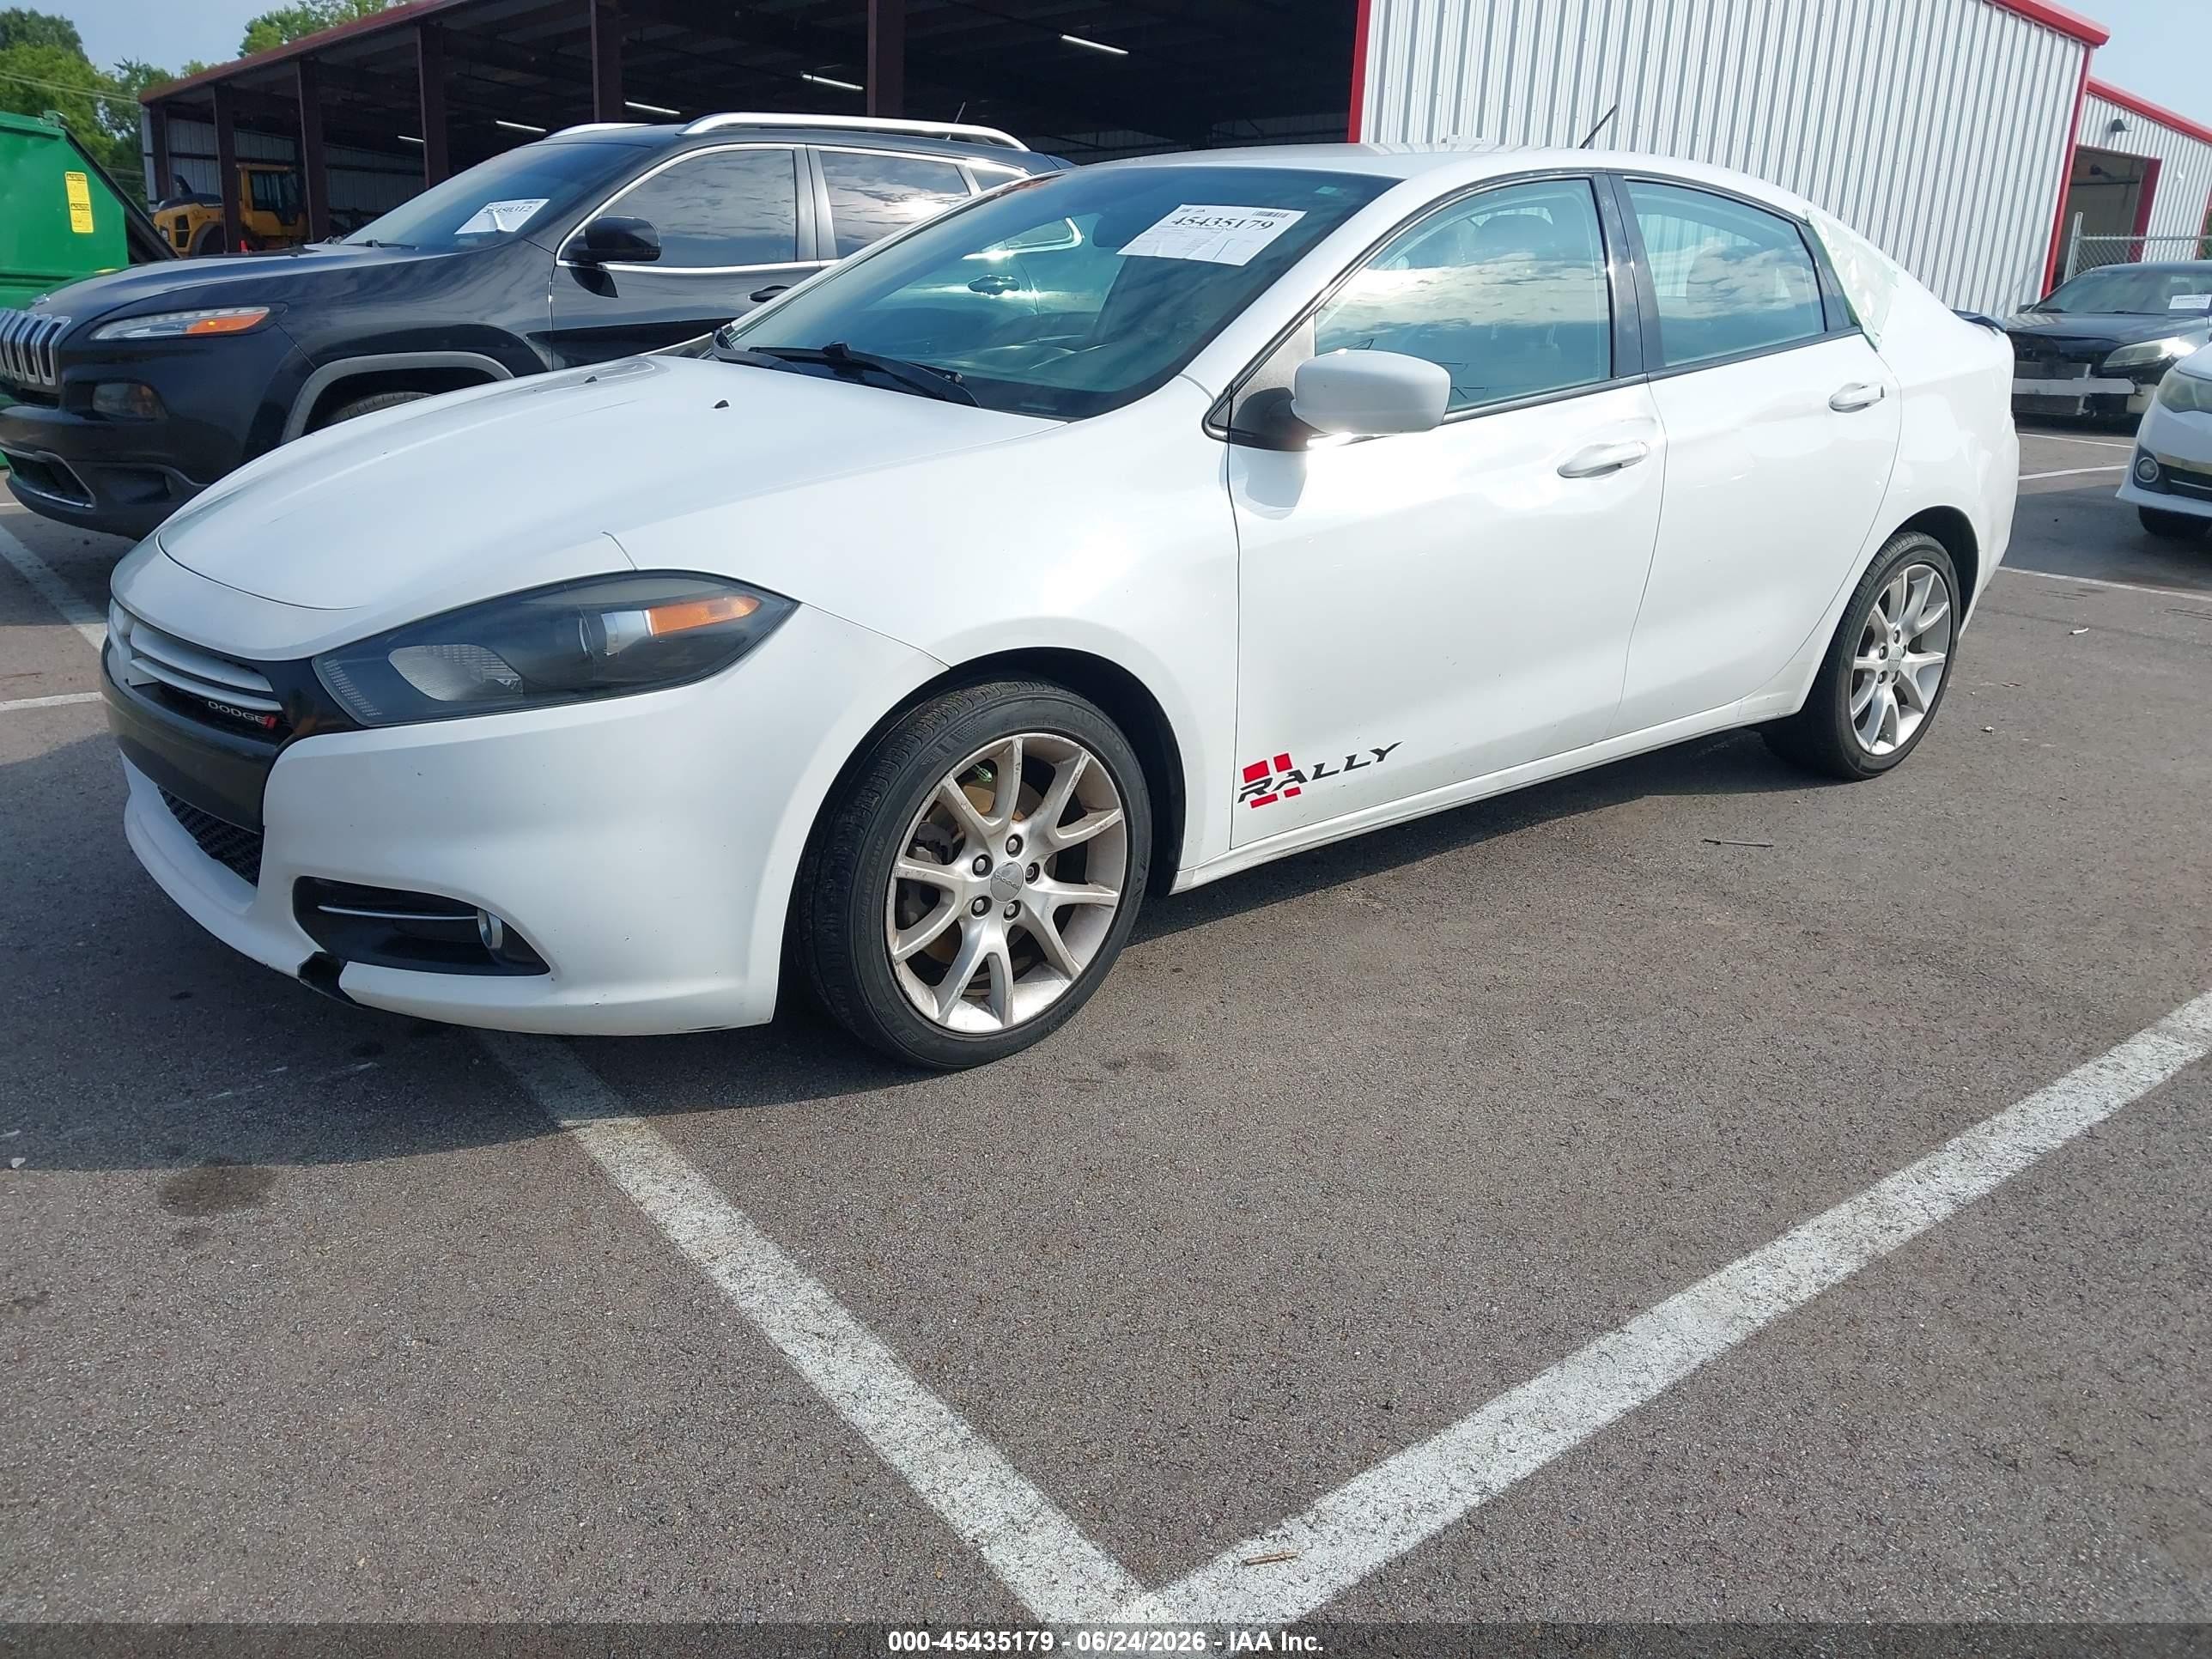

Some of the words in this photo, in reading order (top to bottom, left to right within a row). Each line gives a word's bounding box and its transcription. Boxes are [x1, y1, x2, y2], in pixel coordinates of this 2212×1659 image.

[1170, 216, 1275, 231] 45435179
[208, 701, 268, 727] DODGE
[1237, 740, 1404, 804] RALLY
